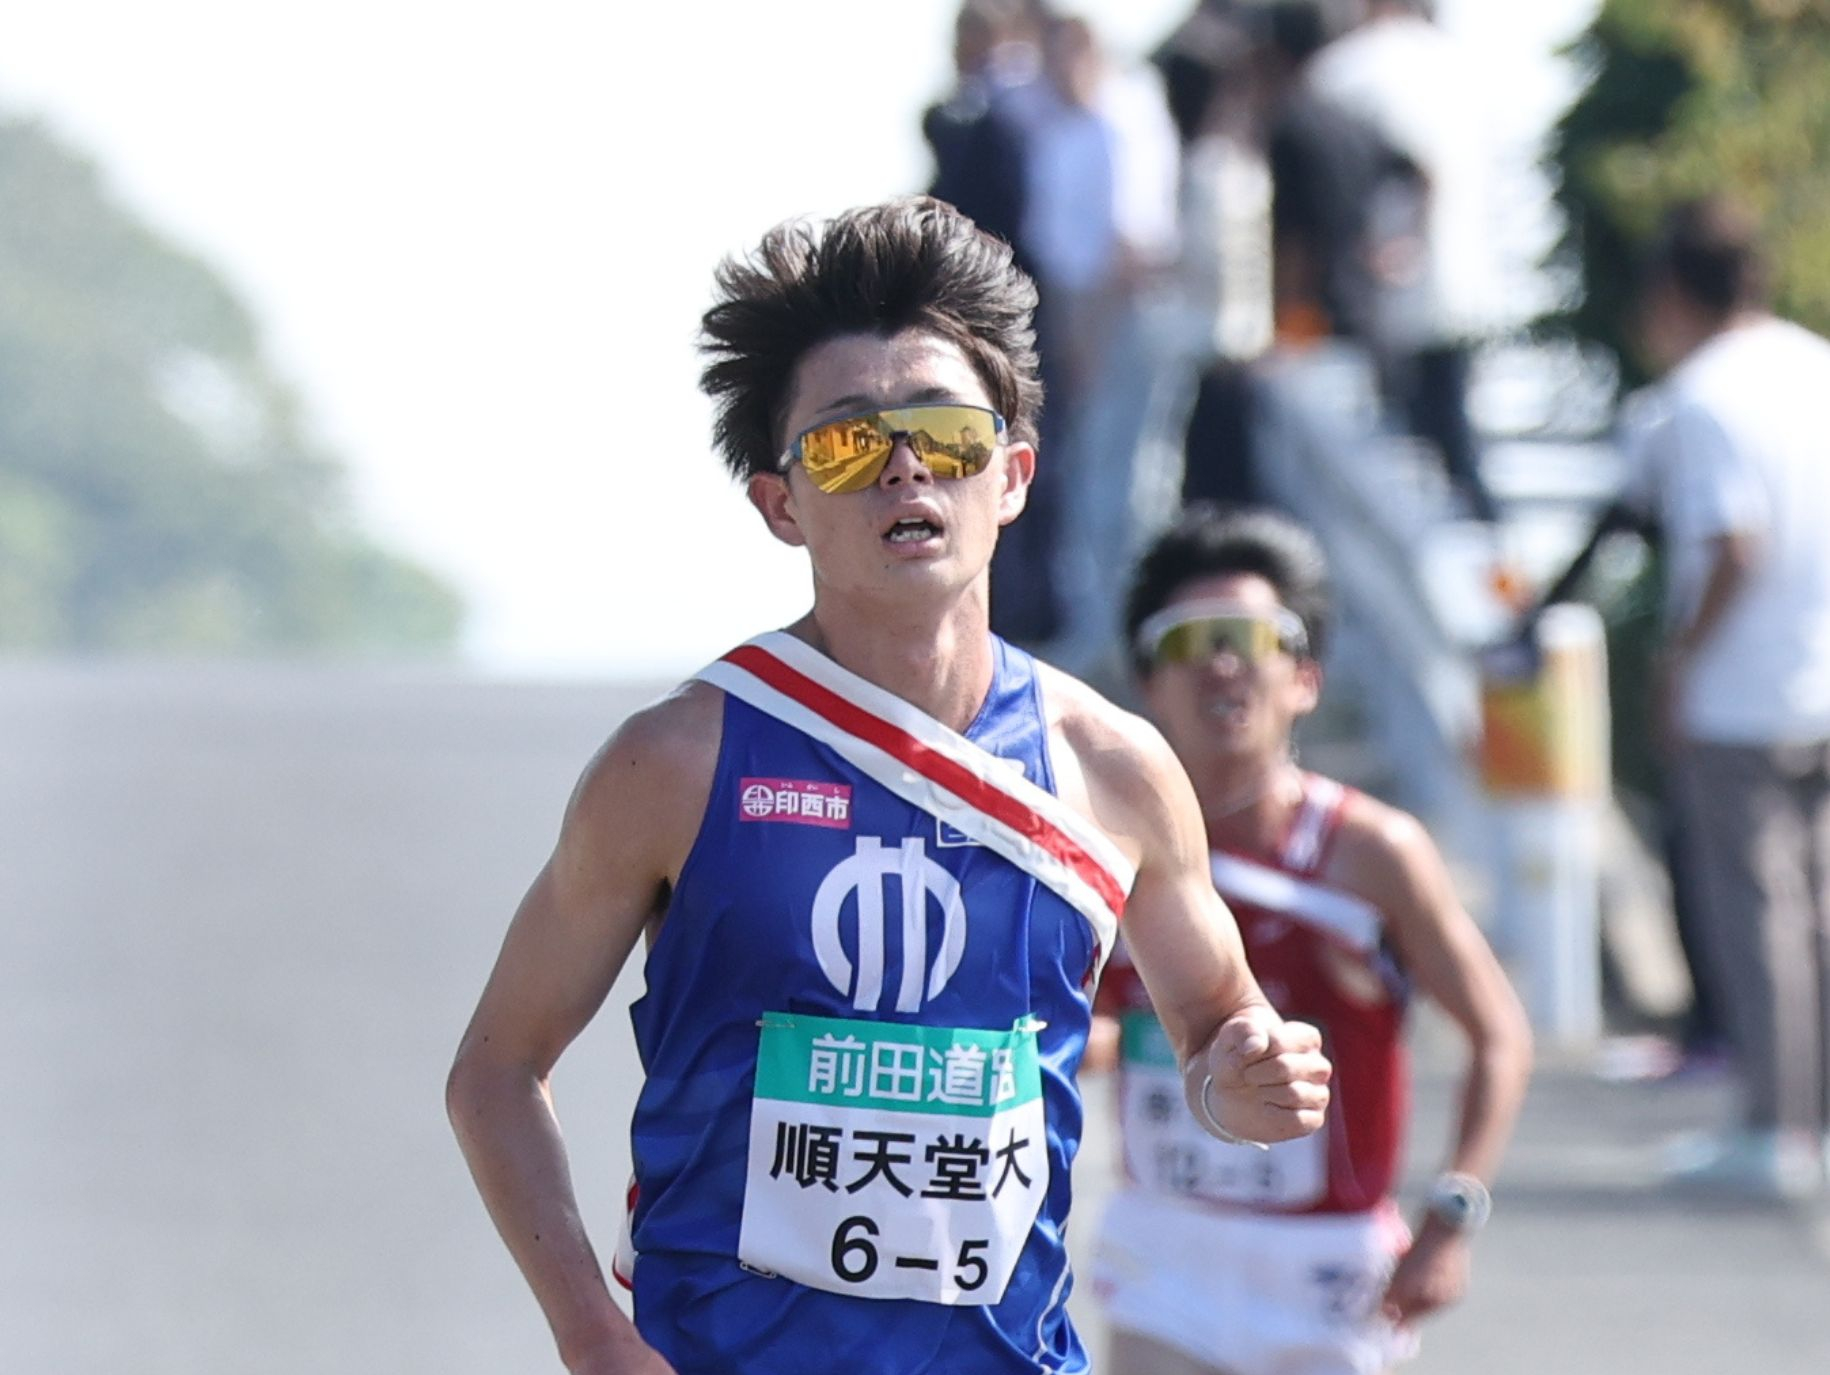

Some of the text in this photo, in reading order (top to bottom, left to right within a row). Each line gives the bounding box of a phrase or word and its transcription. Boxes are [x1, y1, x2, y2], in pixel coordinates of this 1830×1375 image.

[775, 790, 850, 820] 印西市
[770, 1121, 1032, 1201] 順天堂大
